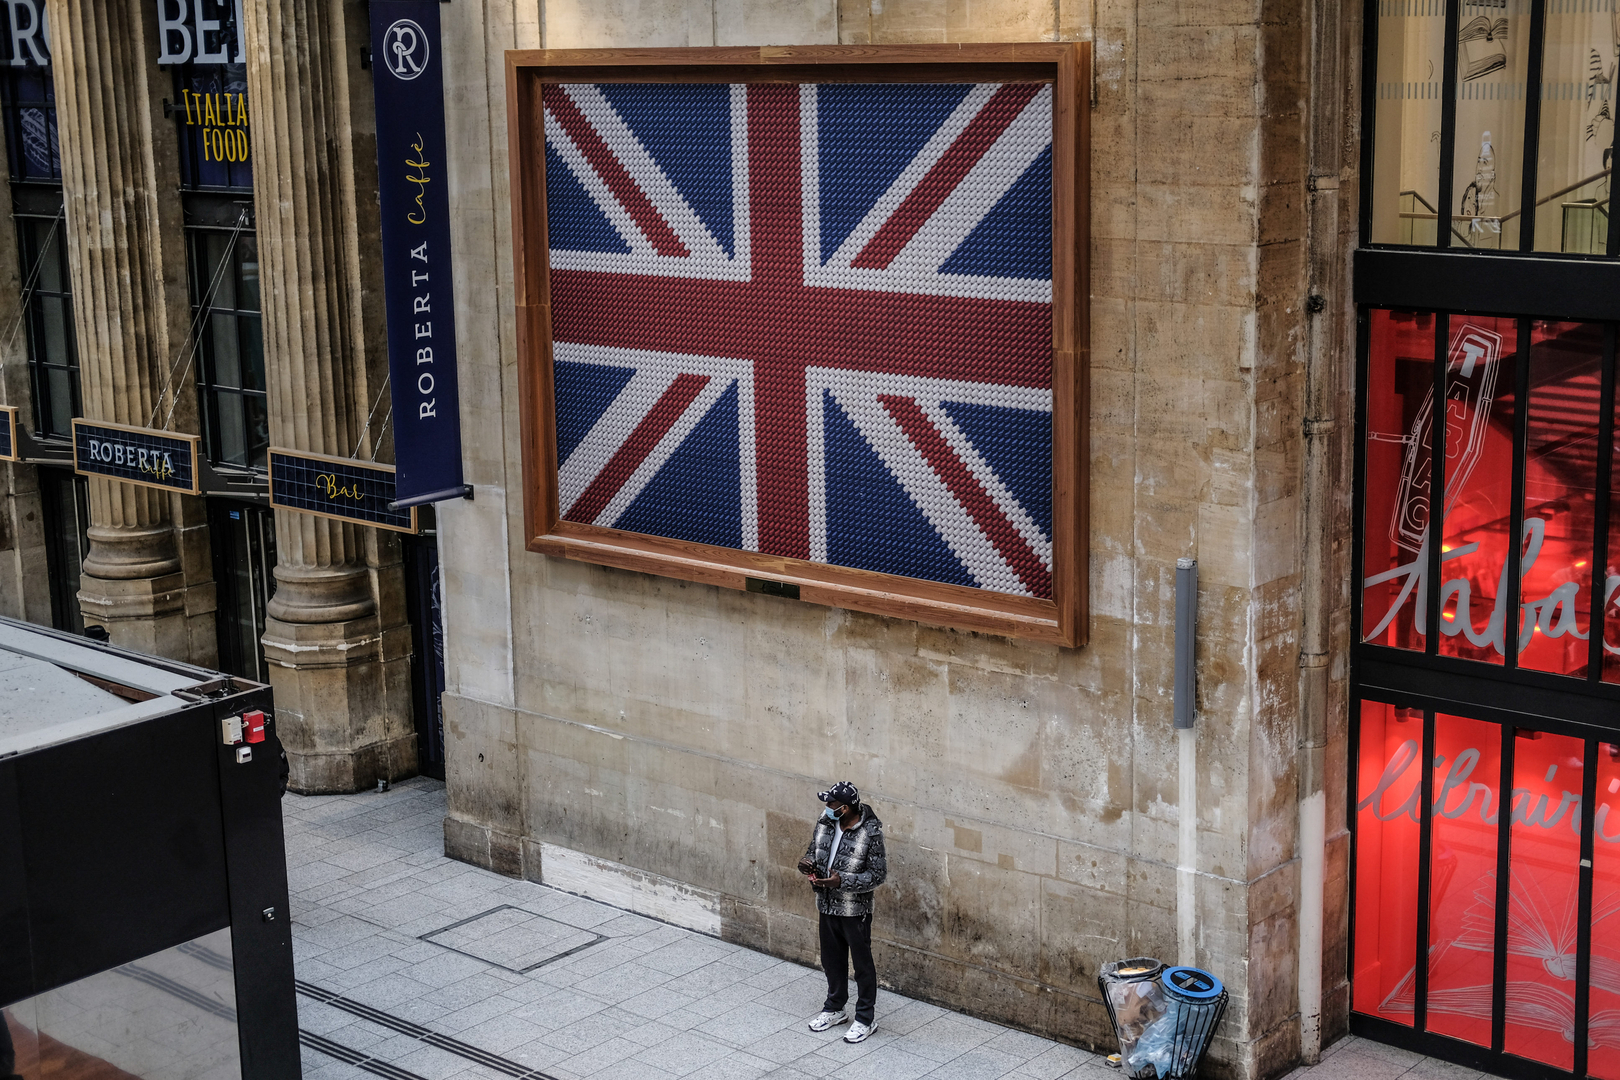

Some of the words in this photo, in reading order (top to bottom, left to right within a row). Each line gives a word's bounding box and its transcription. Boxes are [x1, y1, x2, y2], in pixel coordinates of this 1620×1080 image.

[203, 128, 249, 162] FOOD
[405, 131, 431, 225] Caffè
[410, 240, 437, 420] ROBERTA
[89, 439, 176, 474] ROBERTA
[315, 473, 365, 500] Bar
